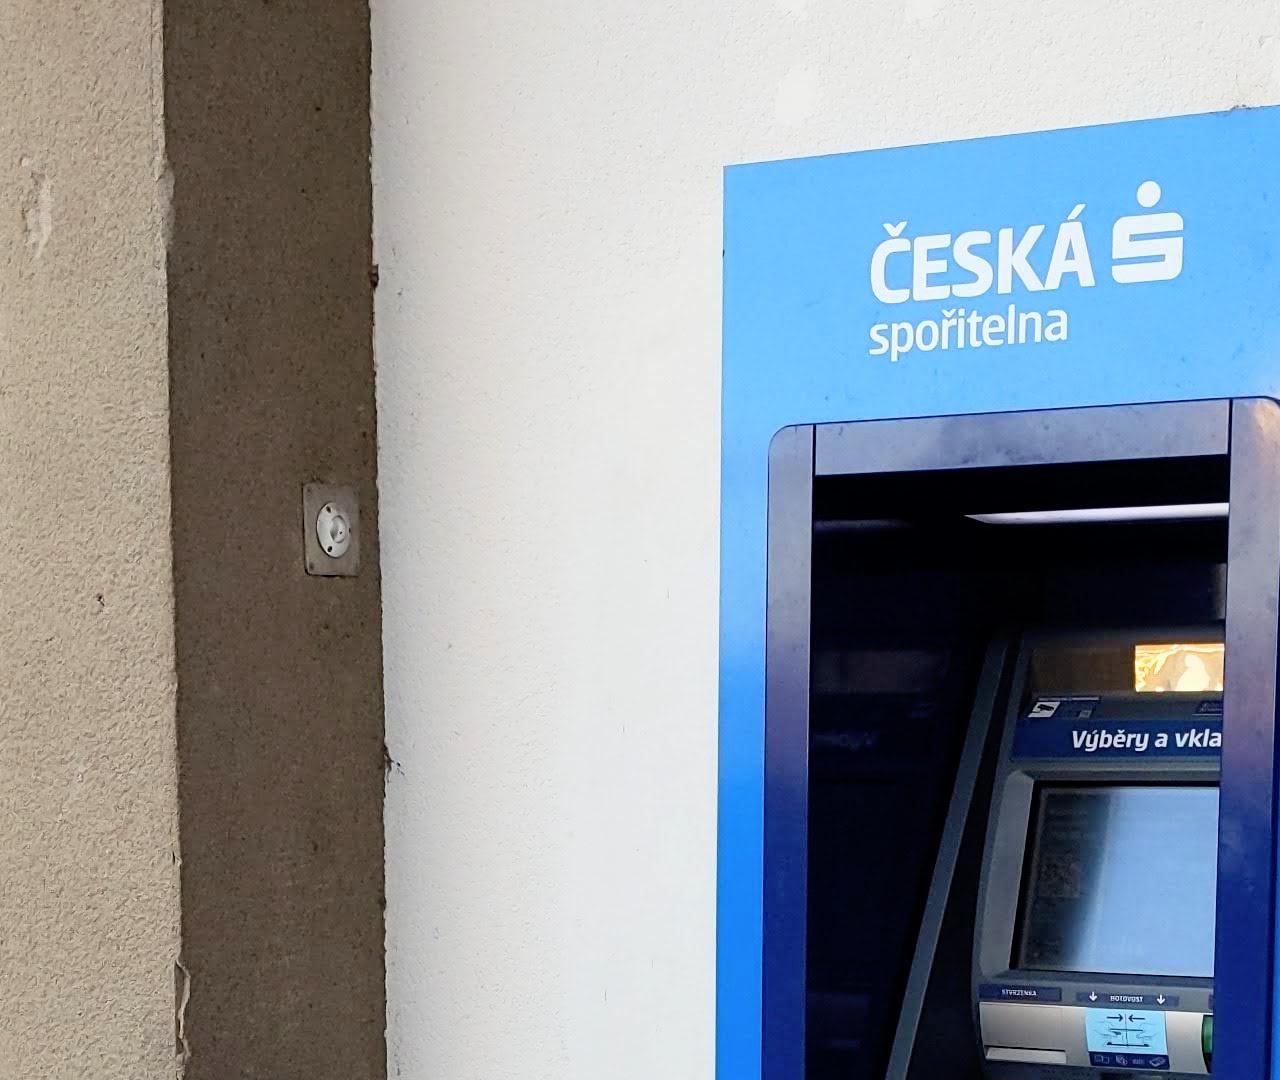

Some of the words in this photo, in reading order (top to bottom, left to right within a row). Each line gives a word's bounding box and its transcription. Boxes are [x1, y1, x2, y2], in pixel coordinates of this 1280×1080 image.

[870, 203, 1095, 304] ČESKÁ
[869, 303, 1068, 362] spořitelna
[1072, 729, 1150, 752] Výběry
[1154, 732, 1168, 748] a
